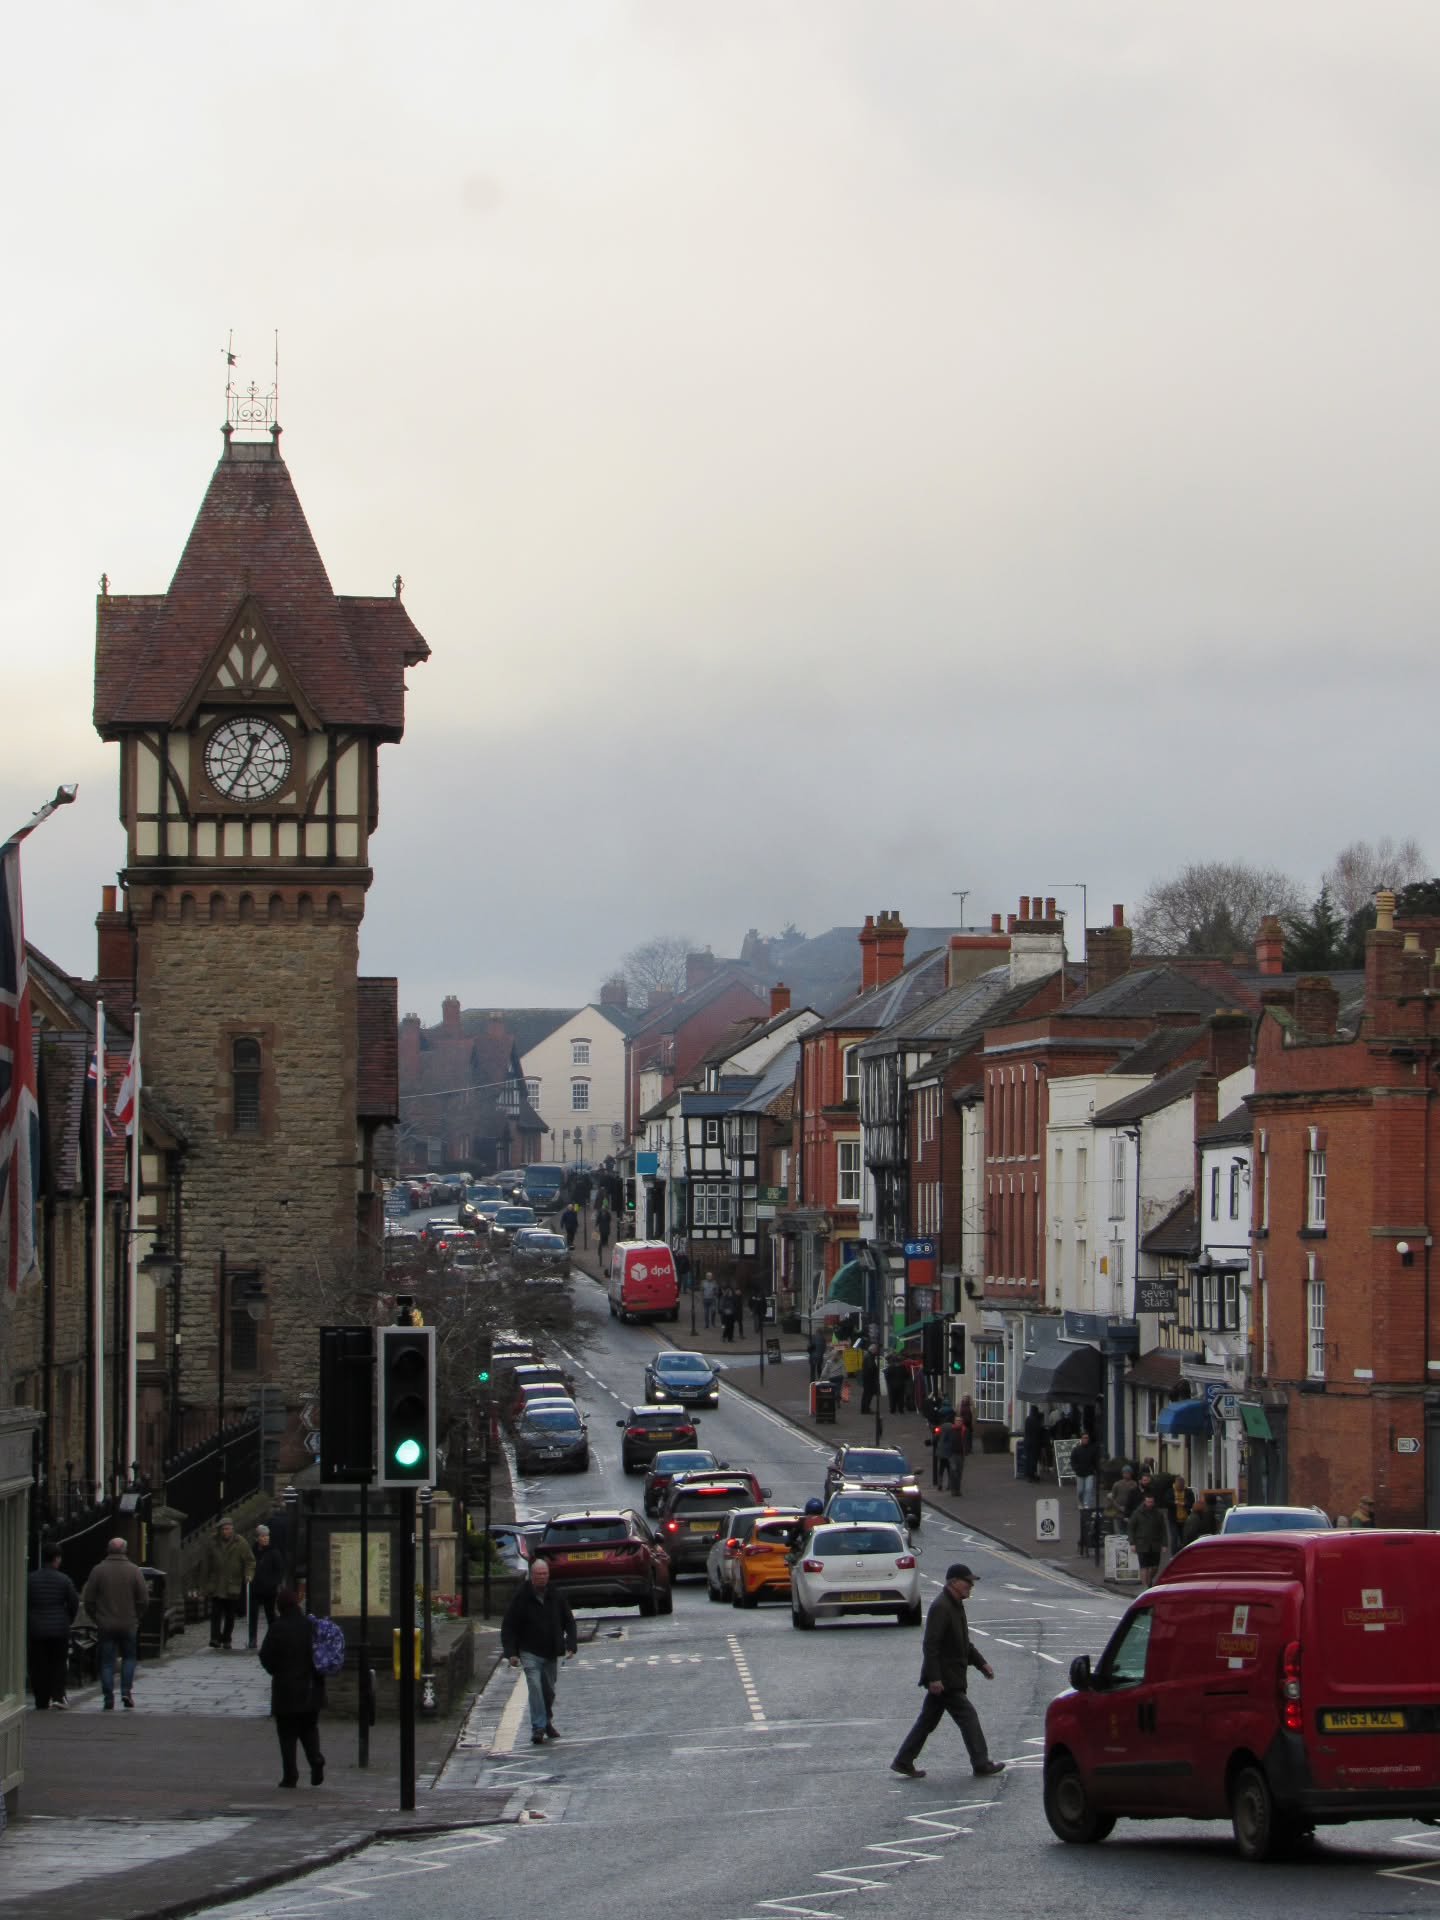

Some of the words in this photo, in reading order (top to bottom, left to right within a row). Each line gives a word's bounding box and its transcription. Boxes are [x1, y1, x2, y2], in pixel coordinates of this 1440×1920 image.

[906, 1244, 931, 1253] TSB
[650, 1264, 671, 1278] dpd
[1149, 1282, 1164, 1290] The
[1141, 1289, 1173, 1299] seven
[1144, 1298, 1170, 1307] stars
[1347, 1610, 1377, 1622] Royal
[1378, 1609, 1399, 1619] Mail
[1348, 1764, 1421, 1774] www.royalmail.com
